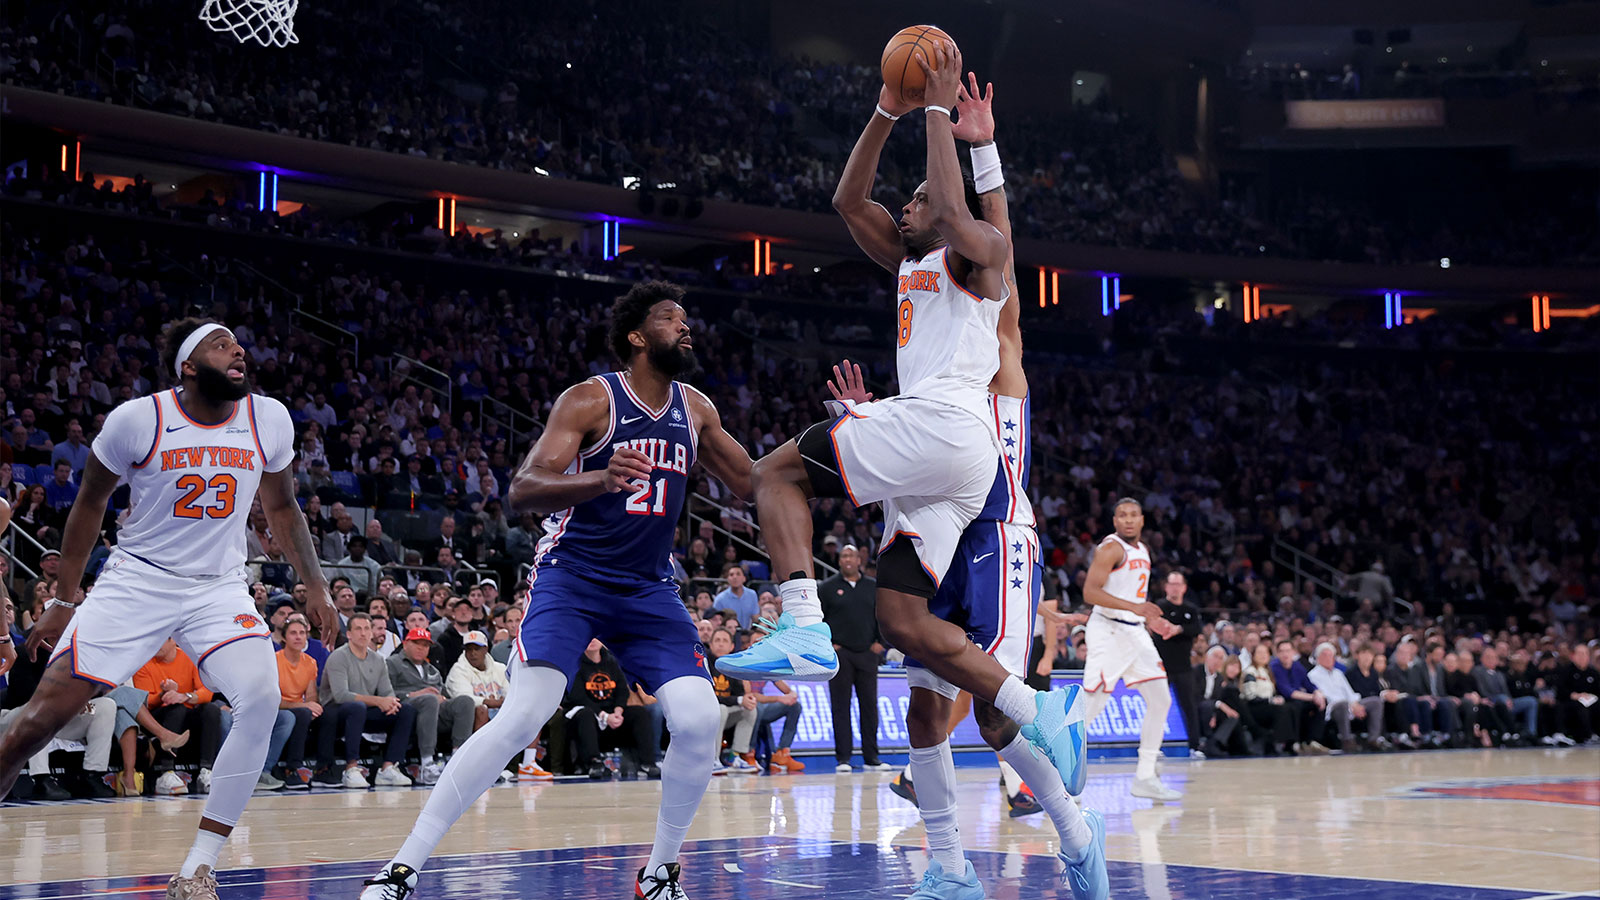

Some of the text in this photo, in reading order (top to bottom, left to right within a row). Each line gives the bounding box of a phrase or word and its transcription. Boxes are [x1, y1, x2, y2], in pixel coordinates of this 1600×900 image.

[899, 298, 914, 348] 8
[161, 446, 255, 471] NEW YORK
[173, 473, 238, 520] 23
[626, 478, 668, 516] 21
[1136, 573, 1147, 598] 2
